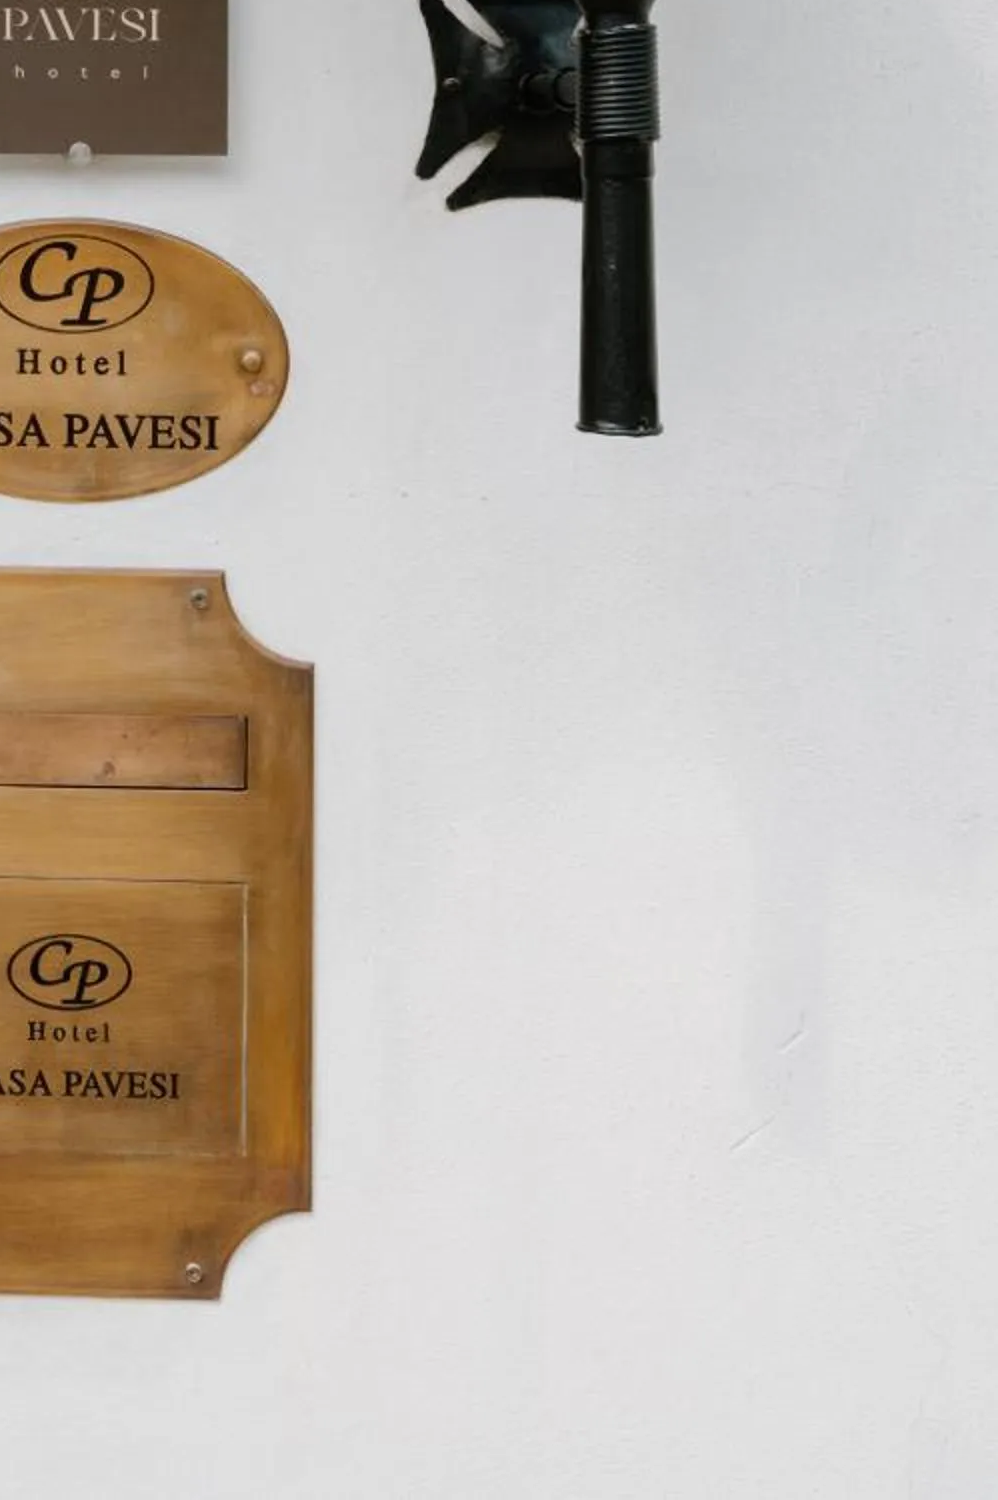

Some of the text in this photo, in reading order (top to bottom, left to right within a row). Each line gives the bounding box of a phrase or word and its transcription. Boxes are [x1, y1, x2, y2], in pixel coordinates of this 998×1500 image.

[2, 7, 161, 42] PAVESI
[14, 64, 149, 80] hotel
[15, 348, 128, 376] Hotel
[63, 412, 221, 451] PAVESI
[26, 1020, 111, 1044] Hotel
[63, 1070, 181, 1101] PAVESI
